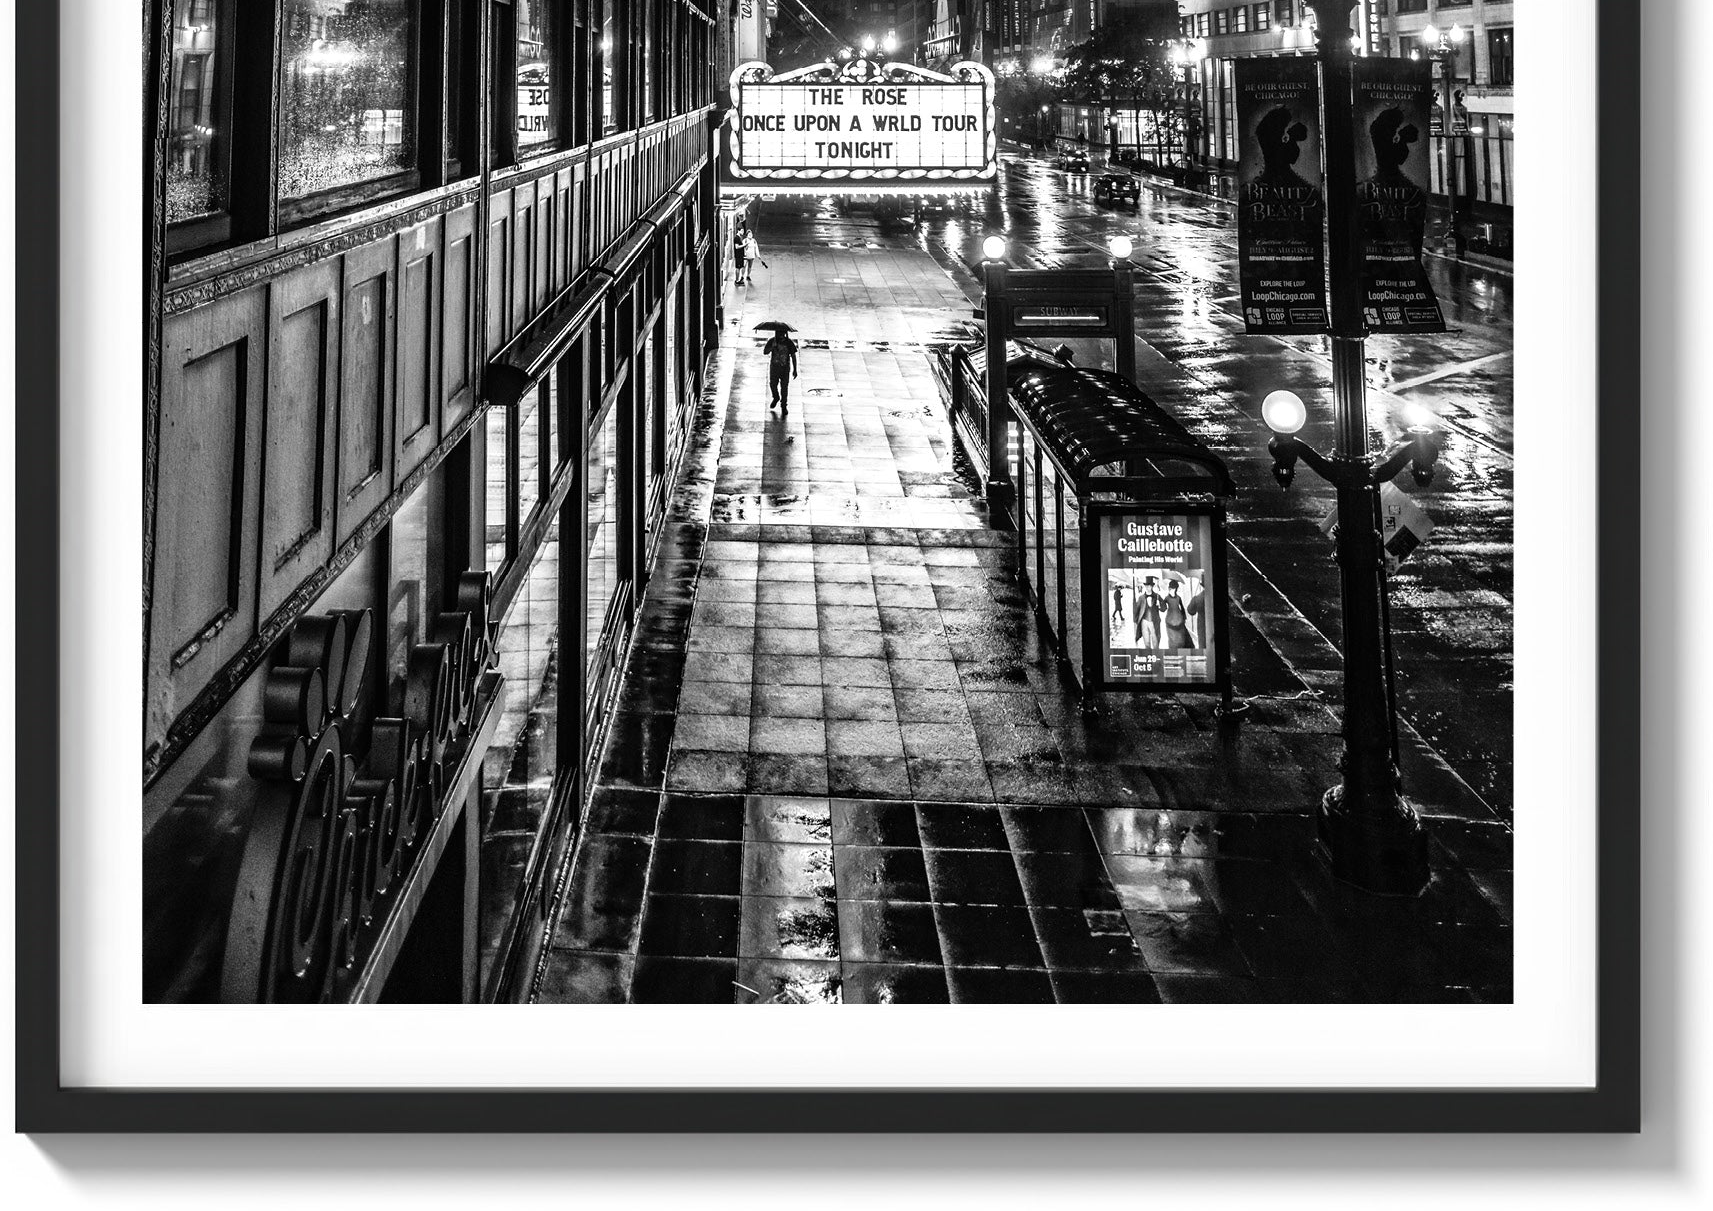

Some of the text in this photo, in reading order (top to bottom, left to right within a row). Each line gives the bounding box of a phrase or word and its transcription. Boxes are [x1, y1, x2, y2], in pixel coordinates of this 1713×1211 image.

[809, 88, 907, 105] THE ROSE
[743, 115, 978, 132] ONCE UPON A WRLD TOUR
[815, 142, 893, 159] TONIGHT
[1251, 291, 1316, 302] LoopChicago.com
[1040, 306, 1079, 316] SUBWAY
[1266, 312, 1286, 321] LOOP
[1383, 312, 1402, 321] LOOP
[1127, 522, 1183, 536] Gustave
[1117, 538, 1193, 553] Caillebotte
[1128, 556, 1154, 564] Painting
[1133, 663, 1146, 671] Oct
